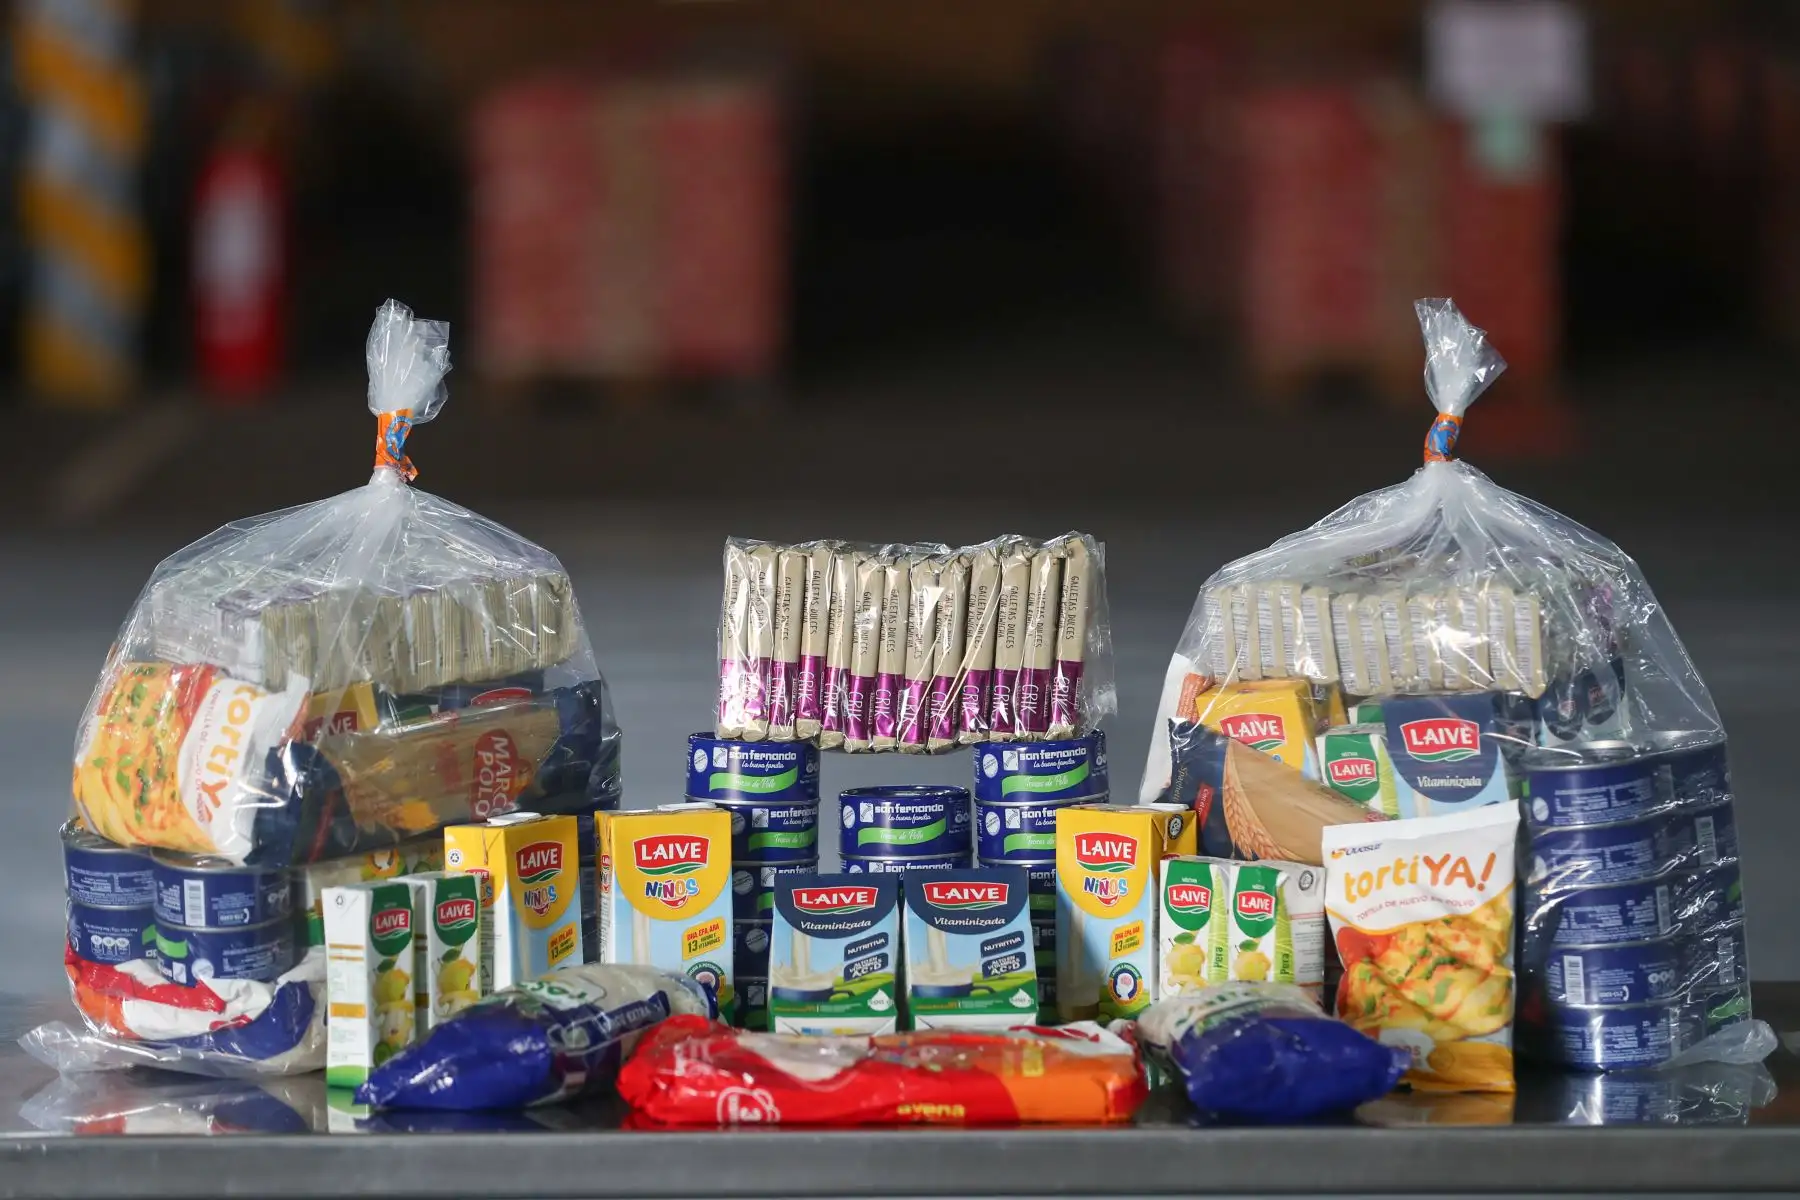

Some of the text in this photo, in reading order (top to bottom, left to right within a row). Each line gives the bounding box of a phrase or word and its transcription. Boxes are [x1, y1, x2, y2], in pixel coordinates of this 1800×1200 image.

[809, 570, 821, 636] GALLETAS DULCES
[976, 586, 988, 620] GALLETAS
[1028, 592, 1036, 606] CON
[1066, 576, 1080, 640] GALLETAS DULCES
[886, 588, 899, 653] GALLETAS DULCES
[998, 594, 1008, 638] CON KIWICHA
[1006, 586, 1018, 650] GALLETAS DULCES
[1034, 622, 1044, 648] DULCES
[798, 671, 814, 702] CRIK
[824, 682, 840, 710] CRIK
[1053, 676, 1070, 708] CRIK
[848, 691, 864, 722] CRIK
[874, 689, 892, 719] CRIK
[930, 691, 947, 722] CRIK
[1020, 684, 1039, 715] CRIK
[1227, 720, 1280, 738] LAIVE
[1410, 726, 1473, 746] LAIVE
[1334, 762, 1372, 777] LAIVE
[474, 750, 495, 817] POLO
[1416, 775, 1482, 788] Vitaminizada
[1042, 818, 1056, 826] buen
[520, 848, 558, 870] LAIVE
[641, 842, 702, 860] LAIVE
[1081, 839, 1132, 859] LAIVE
[1344, 852, 1497, 904] tortiYA!
[801, 891, 868, 905] LAIVE
[932, 887, 1000, 900] LAIVE
[1172, 890, 1207, 904] LAIVE
[1242, 896, 1270, 911] LAIVE
[376, 913, 406, 929] LAIVE
[440, 904, 472, 919] LAIVE
[800, 919, 872, 931] Vitaminizada
[934, 916, 1006, 928] Vitaminizada
[552, 946, 560, 960] 13
[688, 940, 698, 953] 13
[848, 937, 886, 955] NUTRITIVA
[984, 936, 1022, 952] NUTRITIVA
[1114, 940, 1122, 953] 13
[1213, 946, 1224, 968] Pera
[1280, 953, 1290, 976] Pera
